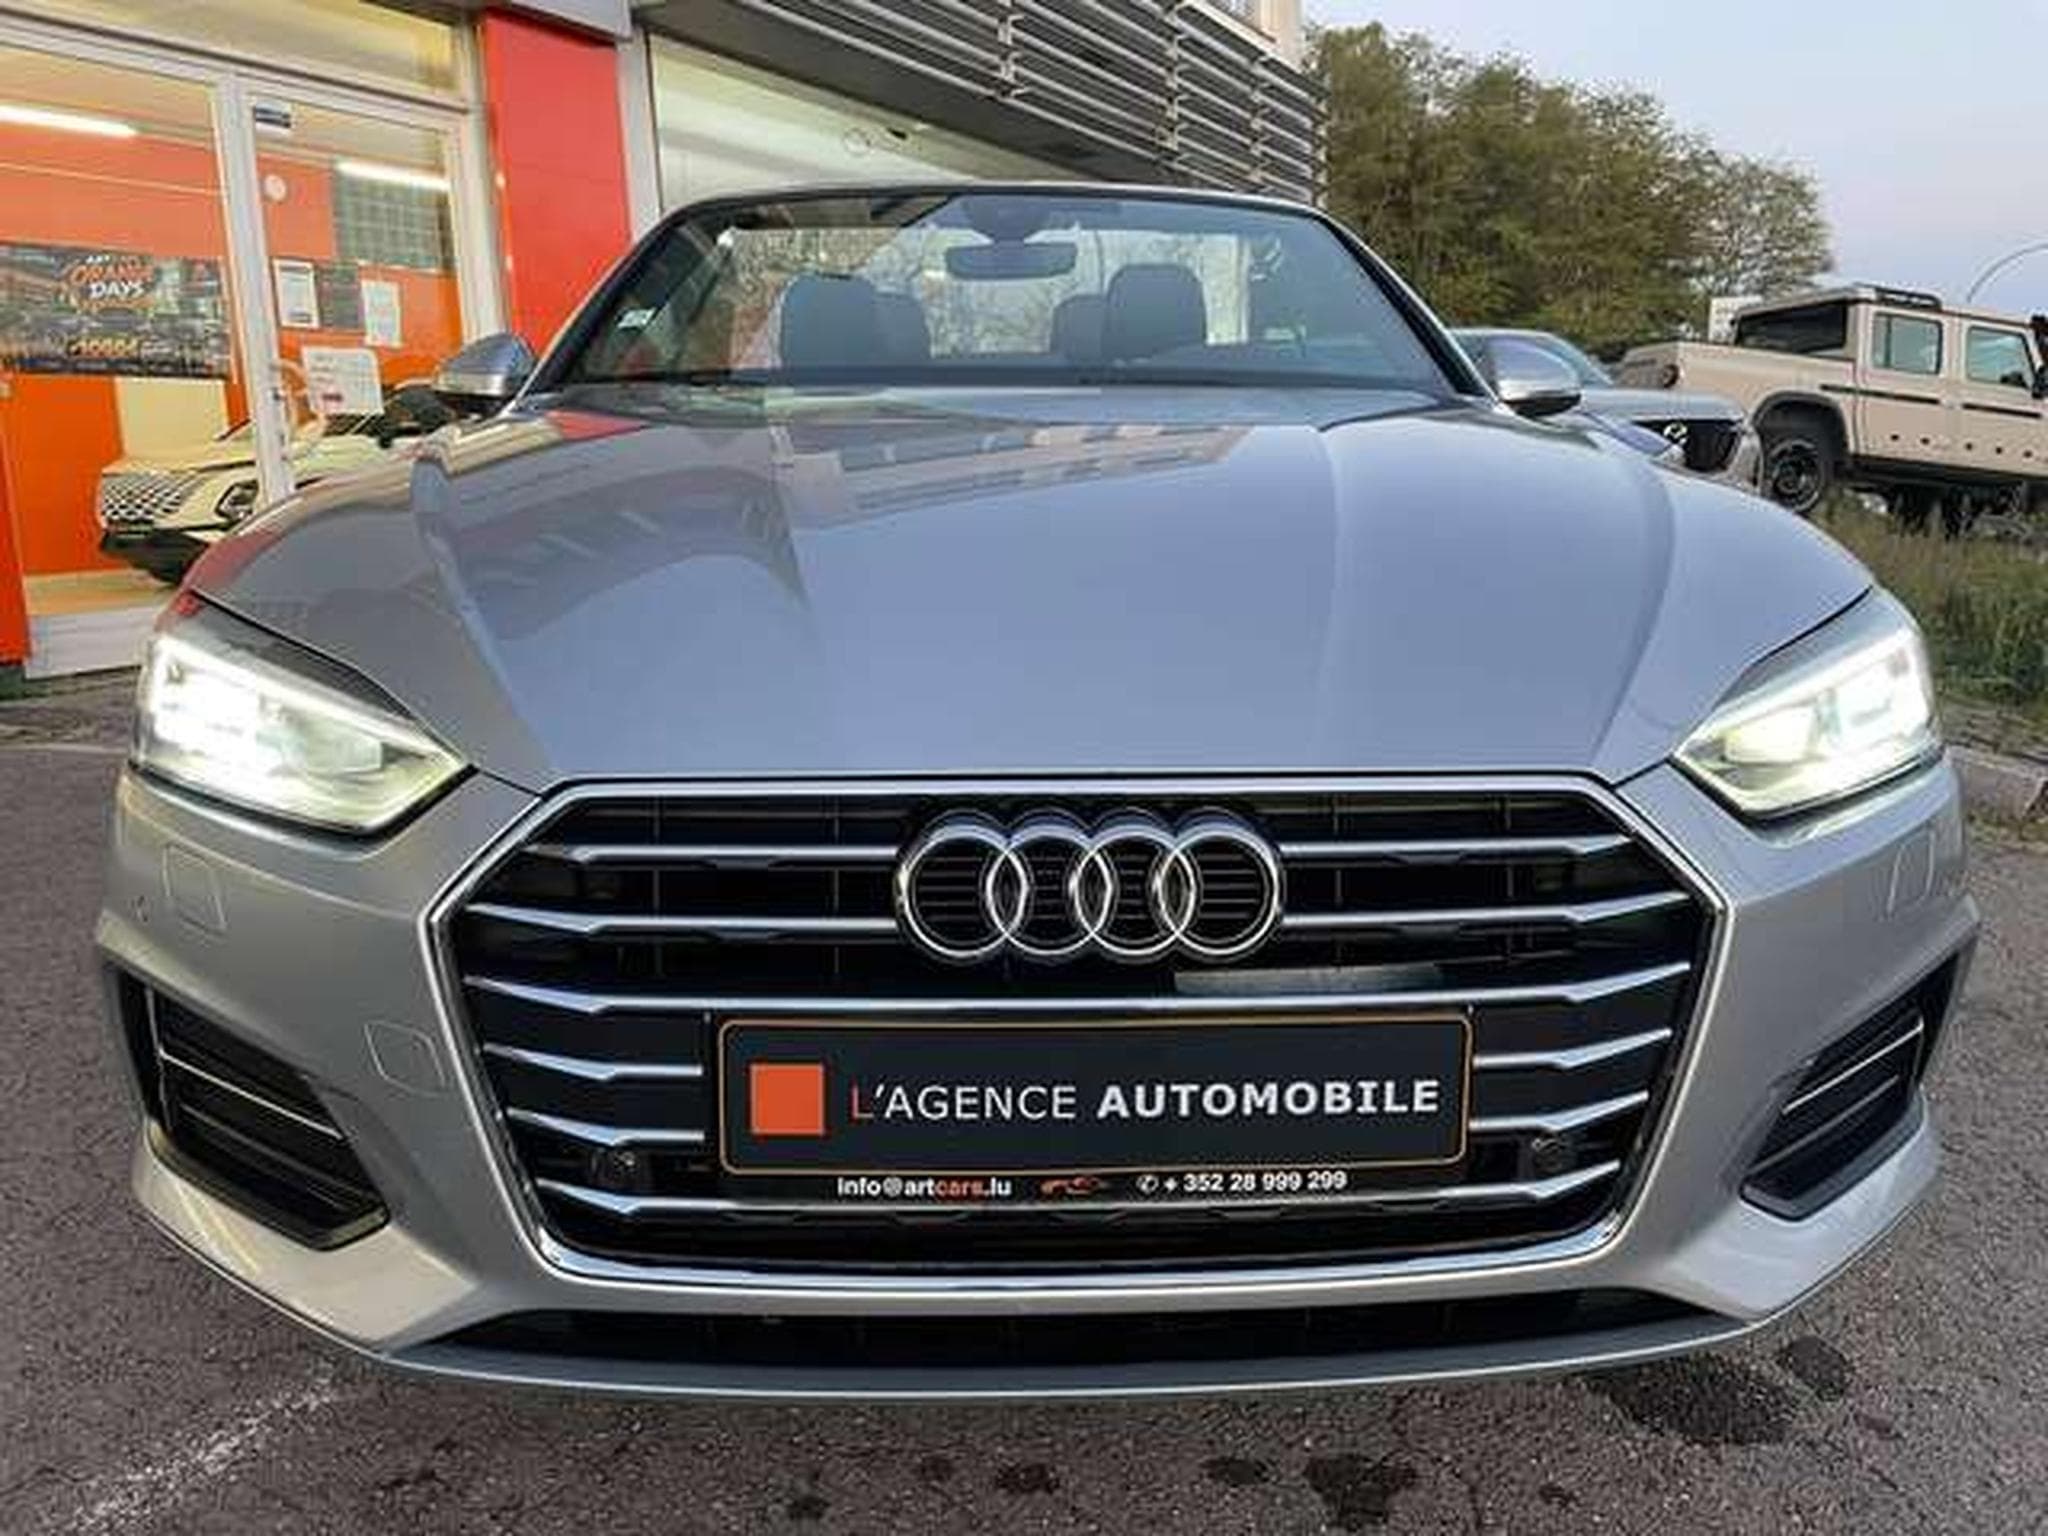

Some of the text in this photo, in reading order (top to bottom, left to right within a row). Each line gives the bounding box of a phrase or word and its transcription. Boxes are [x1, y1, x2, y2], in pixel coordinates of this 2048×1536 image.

[89, 280, 145, 299] DAYS
[850, 1079, 1440, 1120] L'AGENCE AUTOMOBILE
[836, 1175, 1013, 1198] info@artcars.lu
[1183, 1172, 1224, 1193] 352
[1229, 1172, 1257, 1192] 28
[1261, 1171, 1303, 1192] 999
[1307, 1169, 1348, 1190] 299
